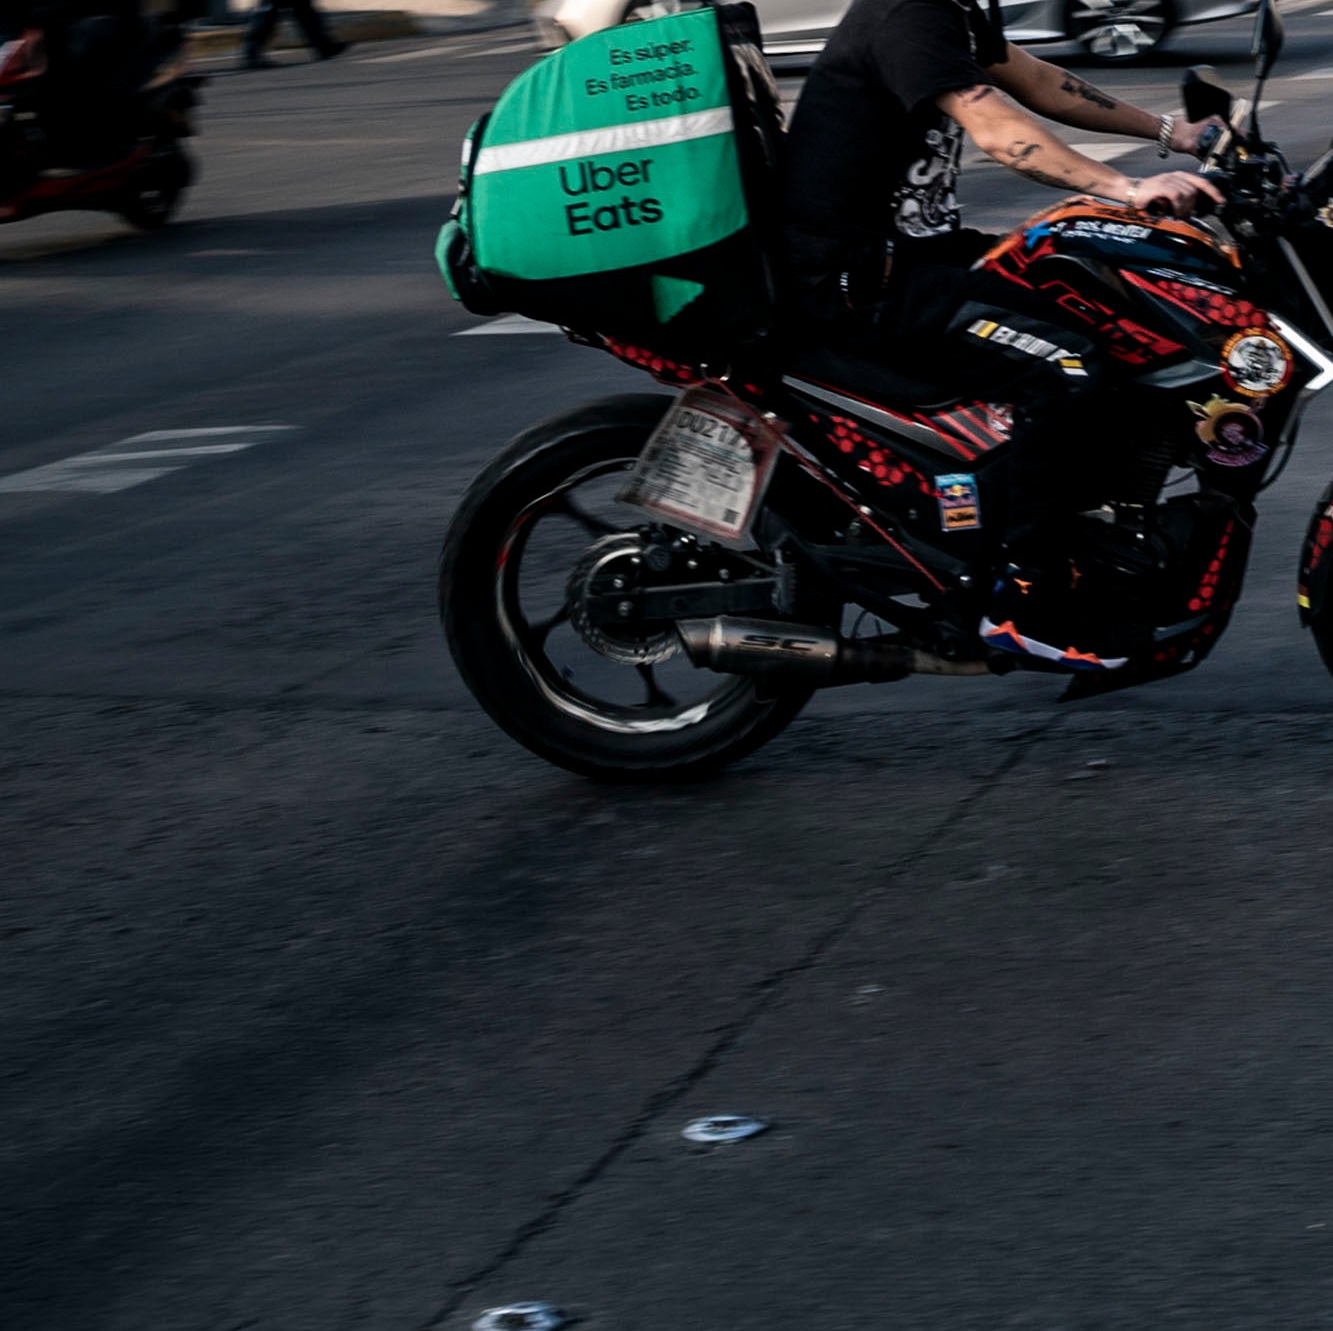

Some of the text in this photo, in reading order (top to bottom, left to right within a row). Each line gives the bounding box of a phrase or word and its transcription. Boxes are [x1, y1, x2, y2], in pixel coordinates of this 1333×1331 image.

[609, 49, 632, 66] Es
[585, 78, 608, 96] Es
[625, 94, 649, 111] Es
[558, 159, 654, 197] Uber
[565, 195, 664, 237] Eats
